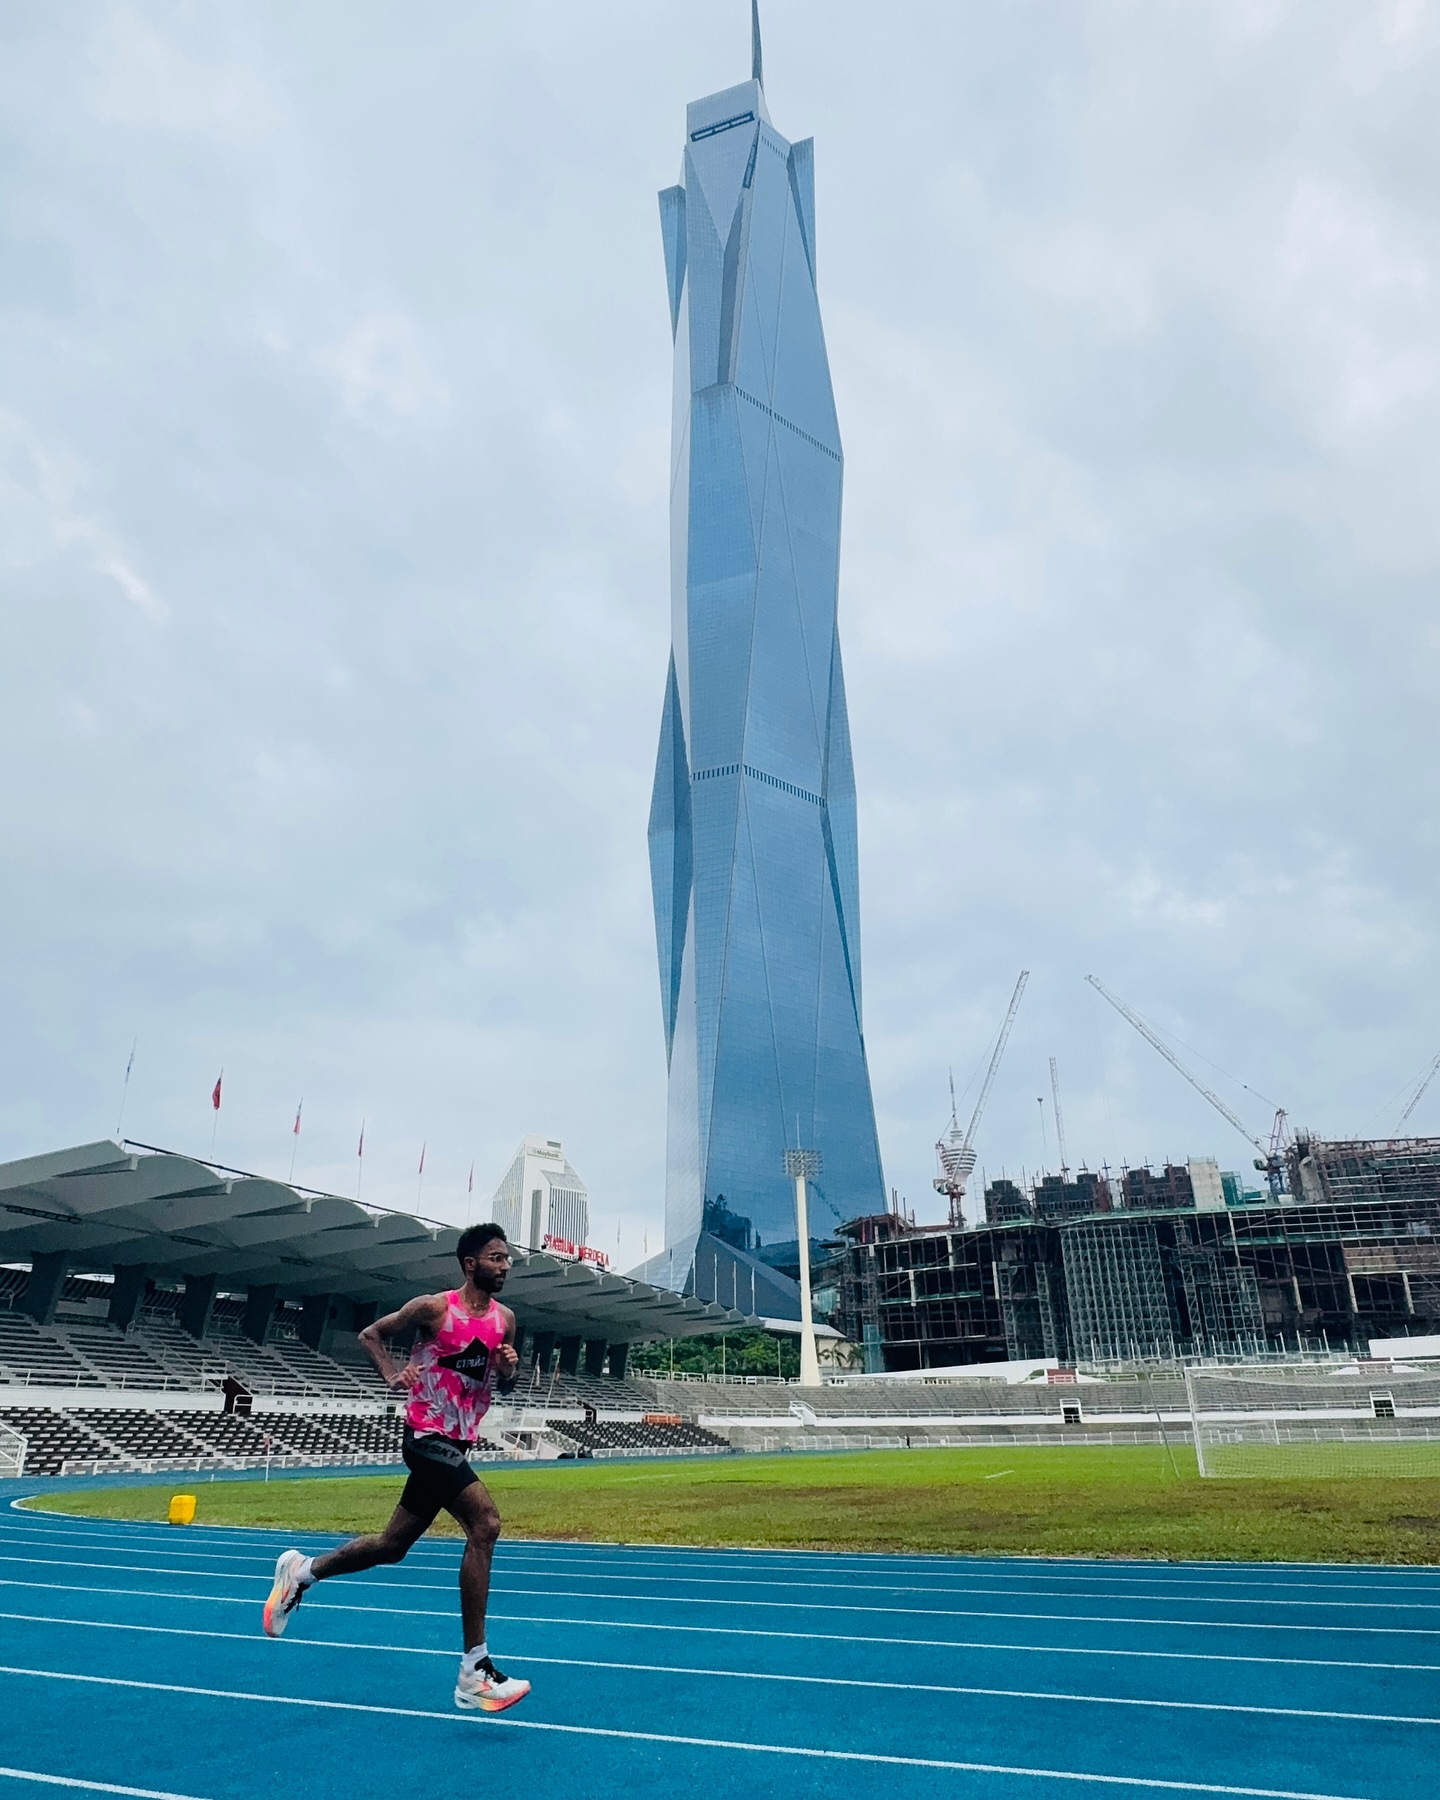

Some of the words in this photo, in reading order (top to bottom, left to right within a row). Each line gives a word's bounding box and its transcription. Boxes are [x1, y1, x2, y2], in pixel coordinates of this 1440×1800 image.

[537, 1149, 559, 1158] Maybank
[544, 1234, 574, 1255] STADIUM
[579, 1245, 609, 1266] MERDEKA
